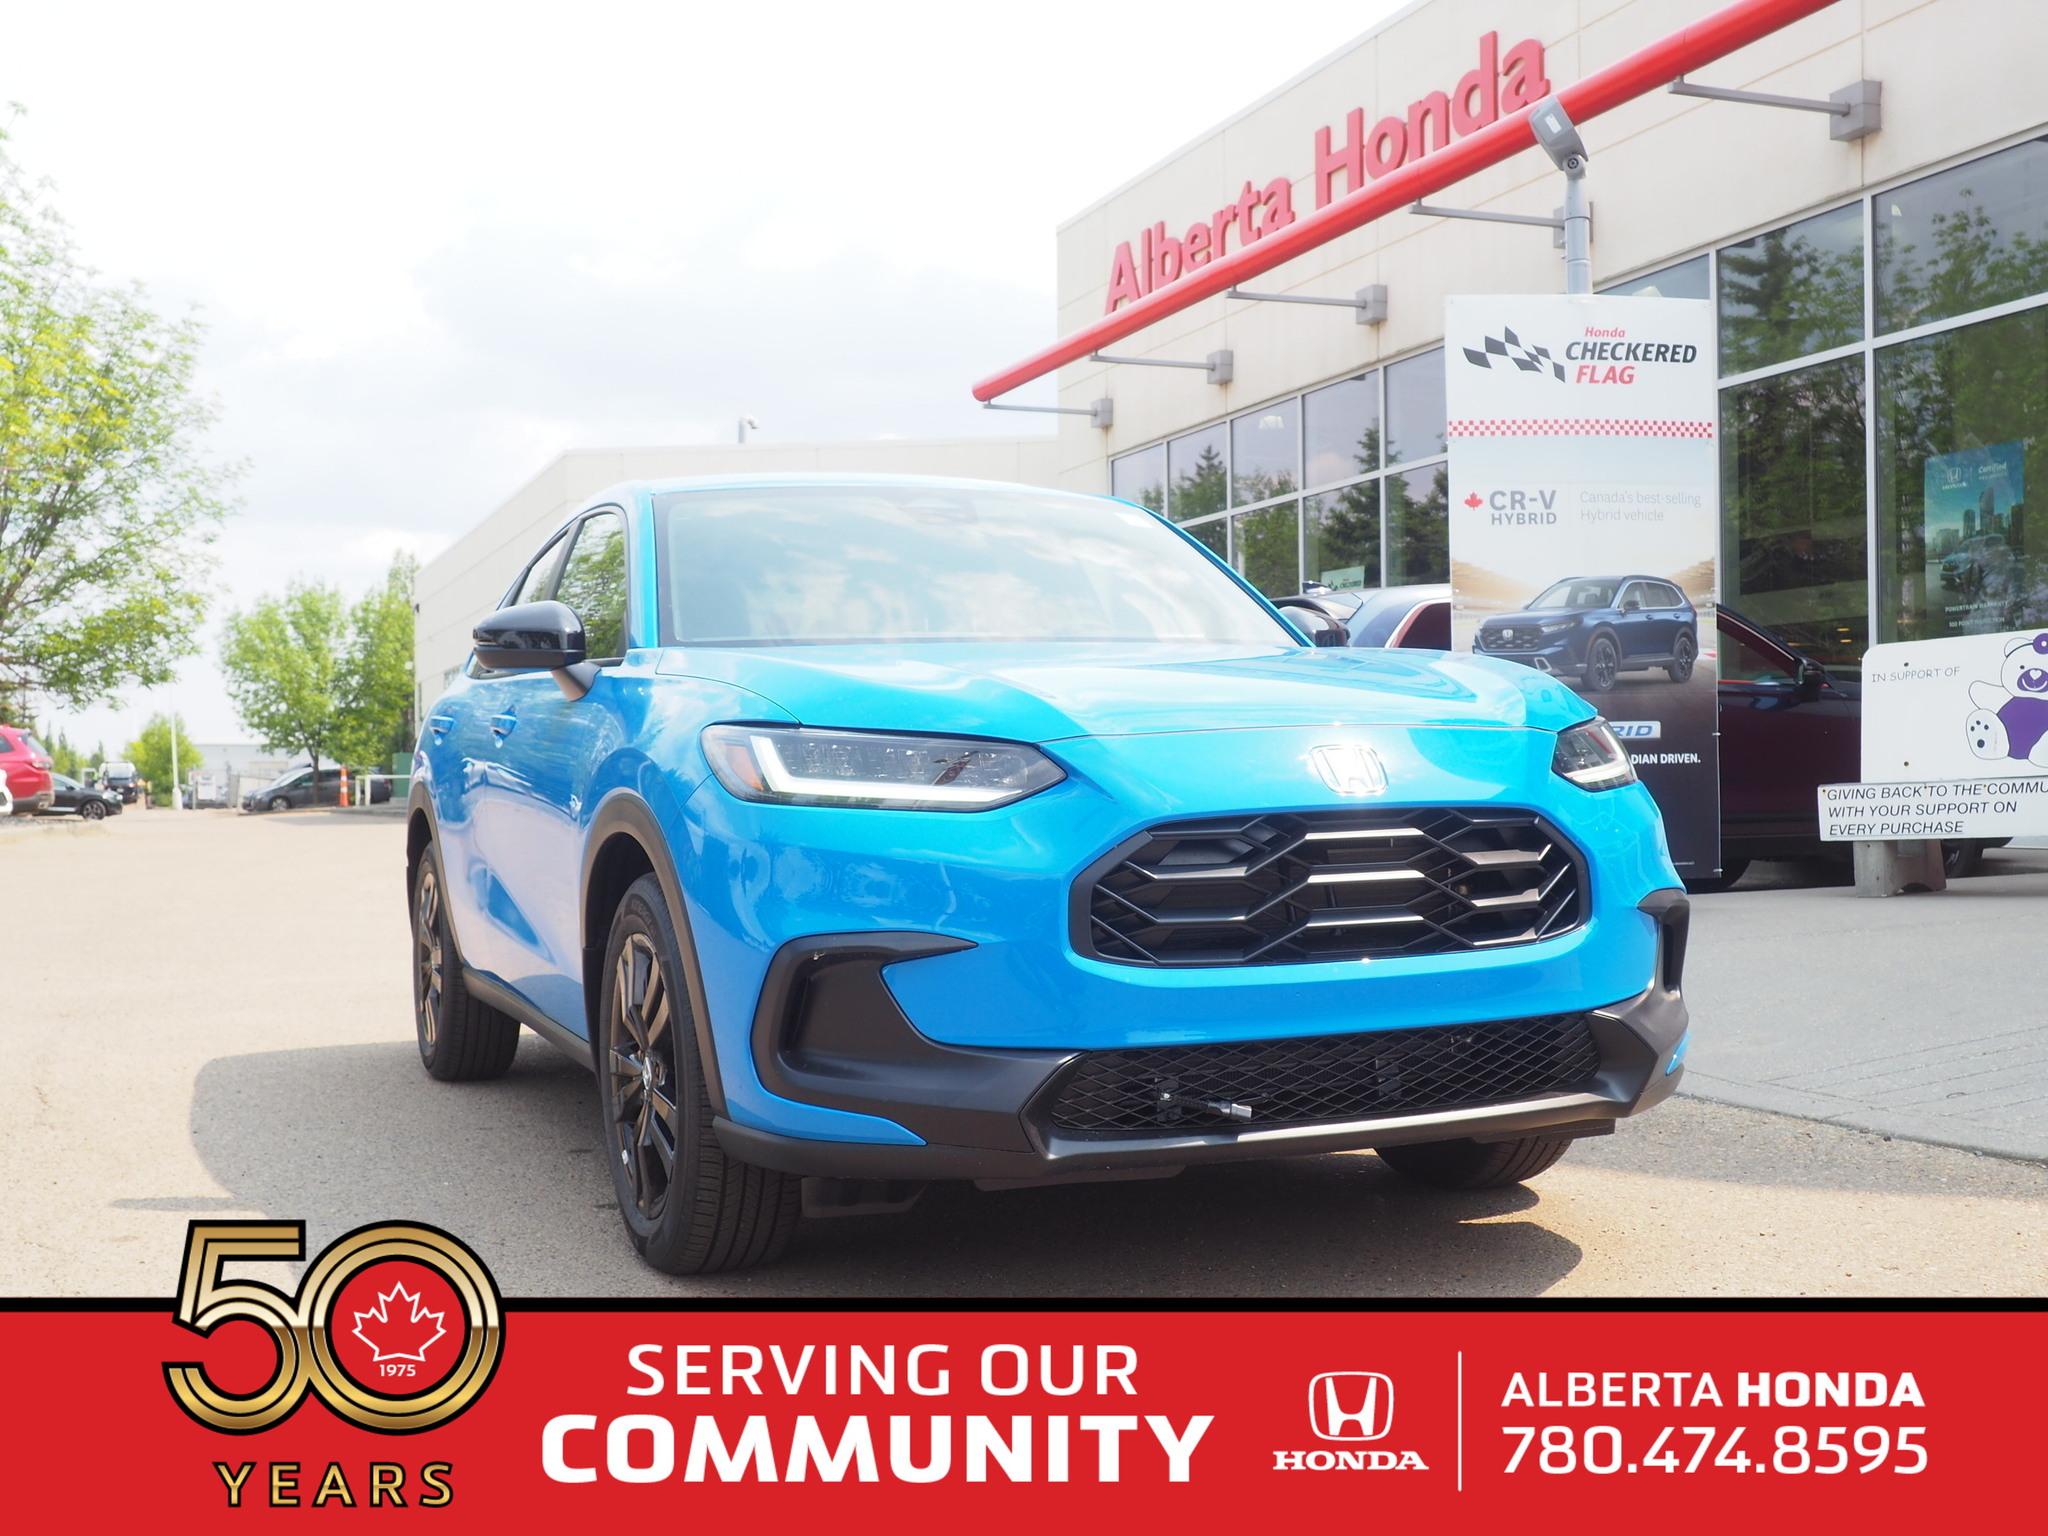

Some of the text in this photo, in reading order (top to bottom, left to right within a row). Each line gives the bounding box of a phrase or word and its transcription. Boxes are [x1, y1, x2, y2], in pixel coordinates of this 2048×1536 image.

[1105, 31, 1551, 316] Alberta Honda
[1585, 327, 1626, 338] Honda
[1565, 341, 1697, 363] CHECKERED
[1576, 365, 1635, 384] FLAG
[1489, 490, 1557, 511] CR-V
[1580, 490, 1702, 508] Canada's best-selling
[1491, 512, 1557, 525] HYBRID
[1581, 508, 1664, 524] Hybrid vehicle
[1872, 666, 1960, 682] IN SUPPORT OF
[1660, 753, 1701, 764] DRIVEN.
[1827, 781, 2048, 801] GIVING BACK TO THE COMMU
[1828, 801, 2018, 818] WITH YOUR SUPPORT ON
[1829, 821, 1965, 836] EVERY PURCHASE
